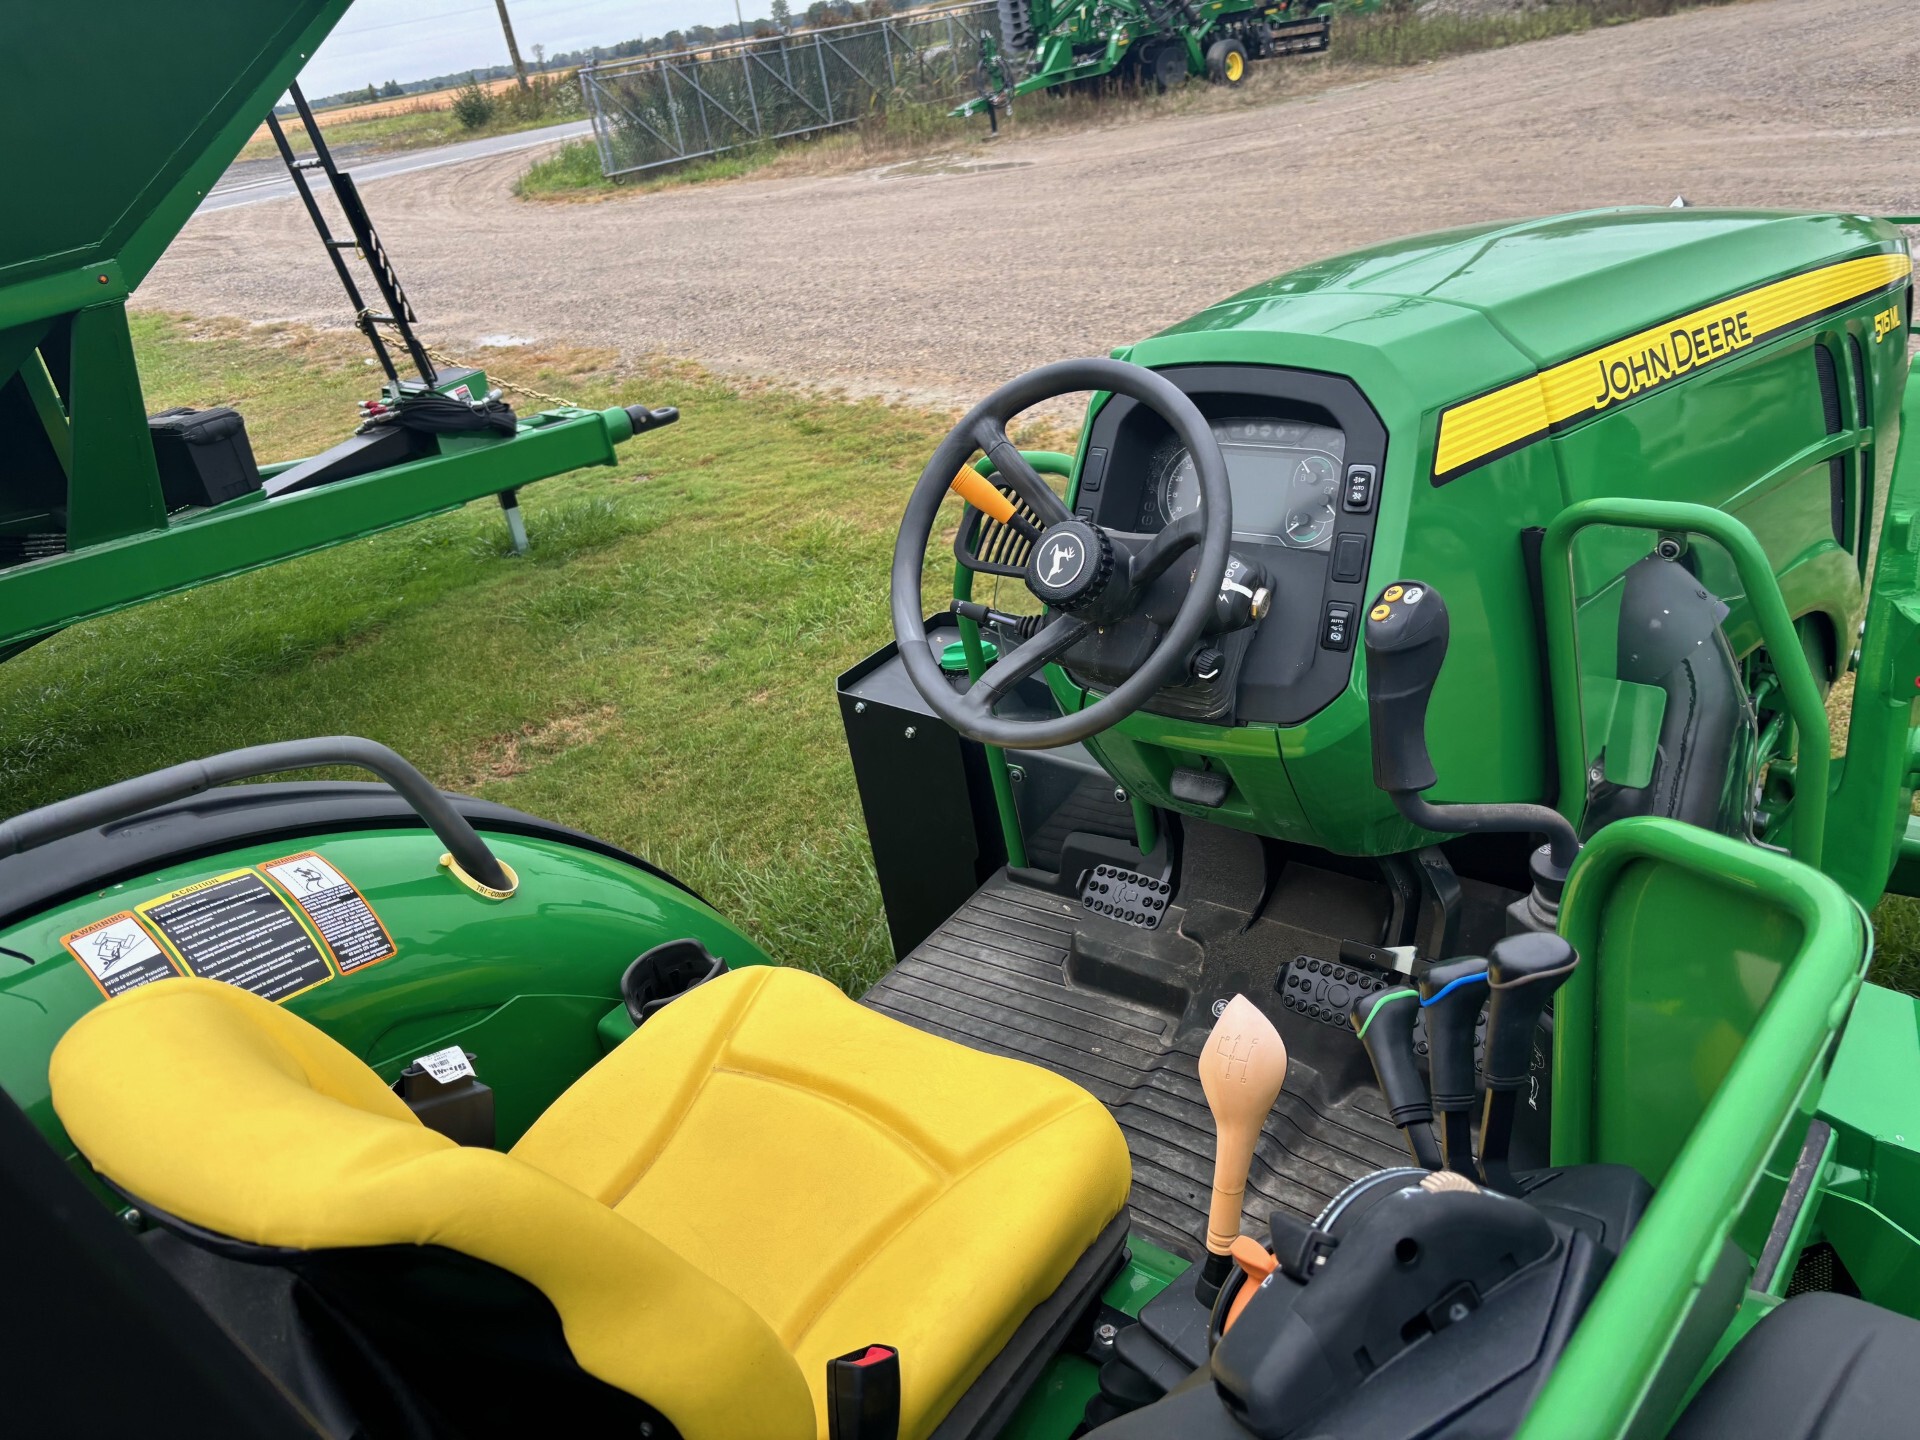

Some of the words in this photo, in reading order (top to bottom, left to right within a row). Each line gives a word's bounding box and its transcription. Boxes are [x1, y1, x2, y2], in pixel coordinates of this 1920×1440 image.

[1596, 343, 1670, 403] JOHN
[1670, 311, 1751, 369] DEERE
[179, 879, 218, 895] CAUTION
[79, 914, 126, 935] WARNING
